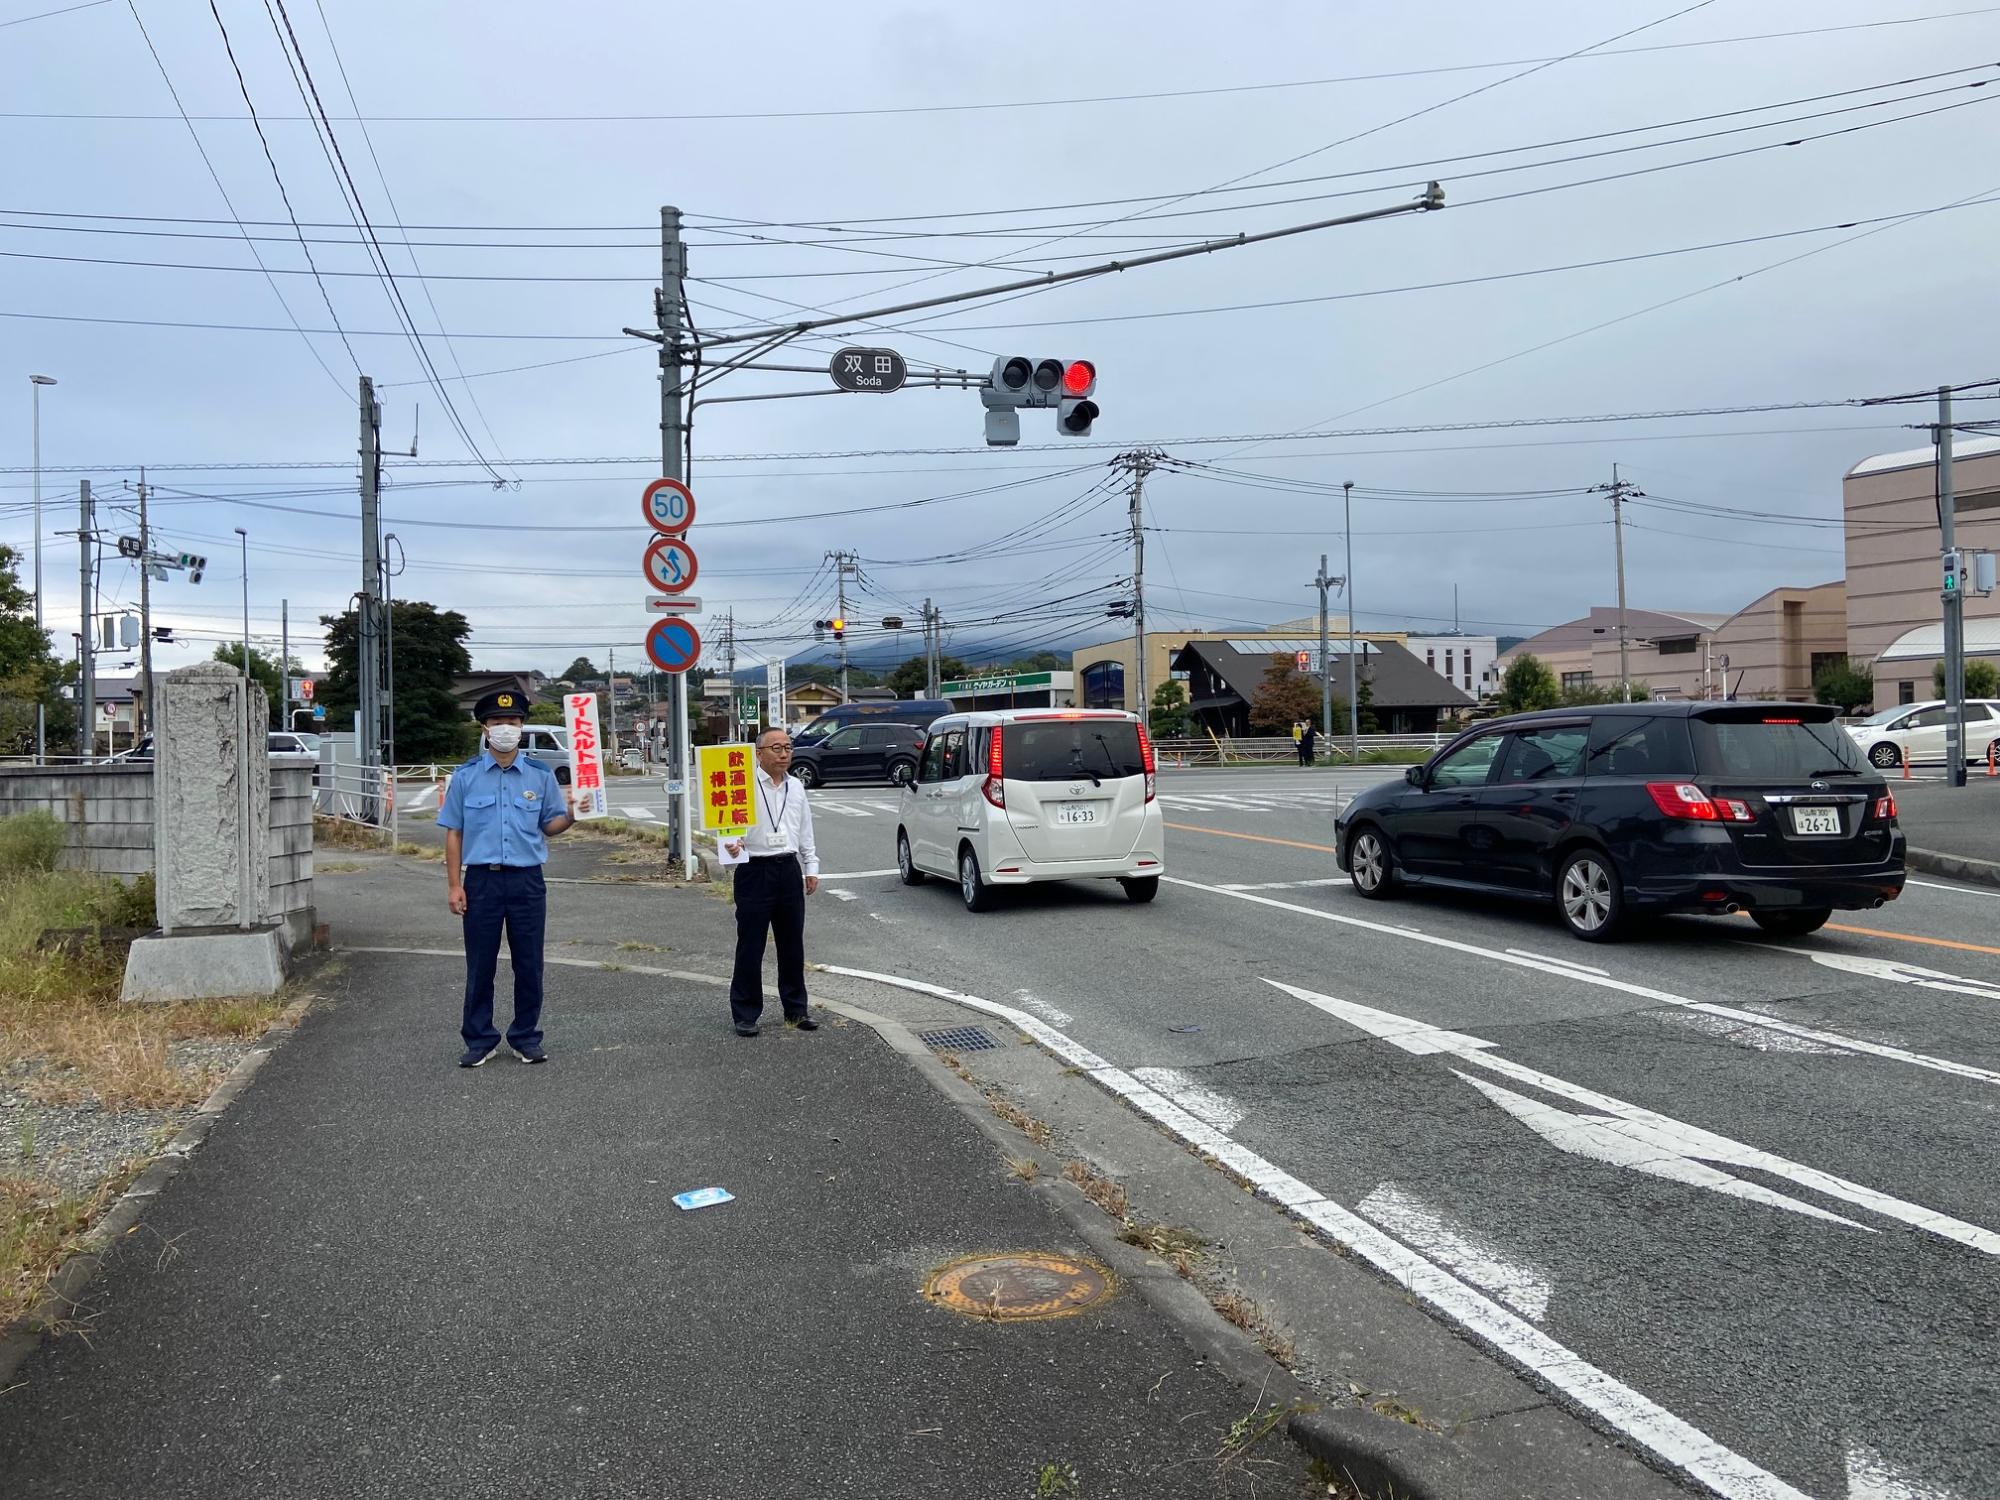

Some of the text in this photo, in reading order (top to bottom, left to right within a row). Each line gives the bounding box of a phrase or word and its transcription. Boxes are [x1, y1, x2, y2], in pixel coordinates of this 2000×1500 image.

[844, 355, 893, 374] 双田
[855, 375, 882, 386] Soda
[655, 493, 684, 519] 50
[571, 696, 600, 789] シートベルト着用
[728, 751, 749, 825] 飲酒運転
[1067, 811, 1094, 822] 16-33
[1805, 818, 1837, 832] 26-21
